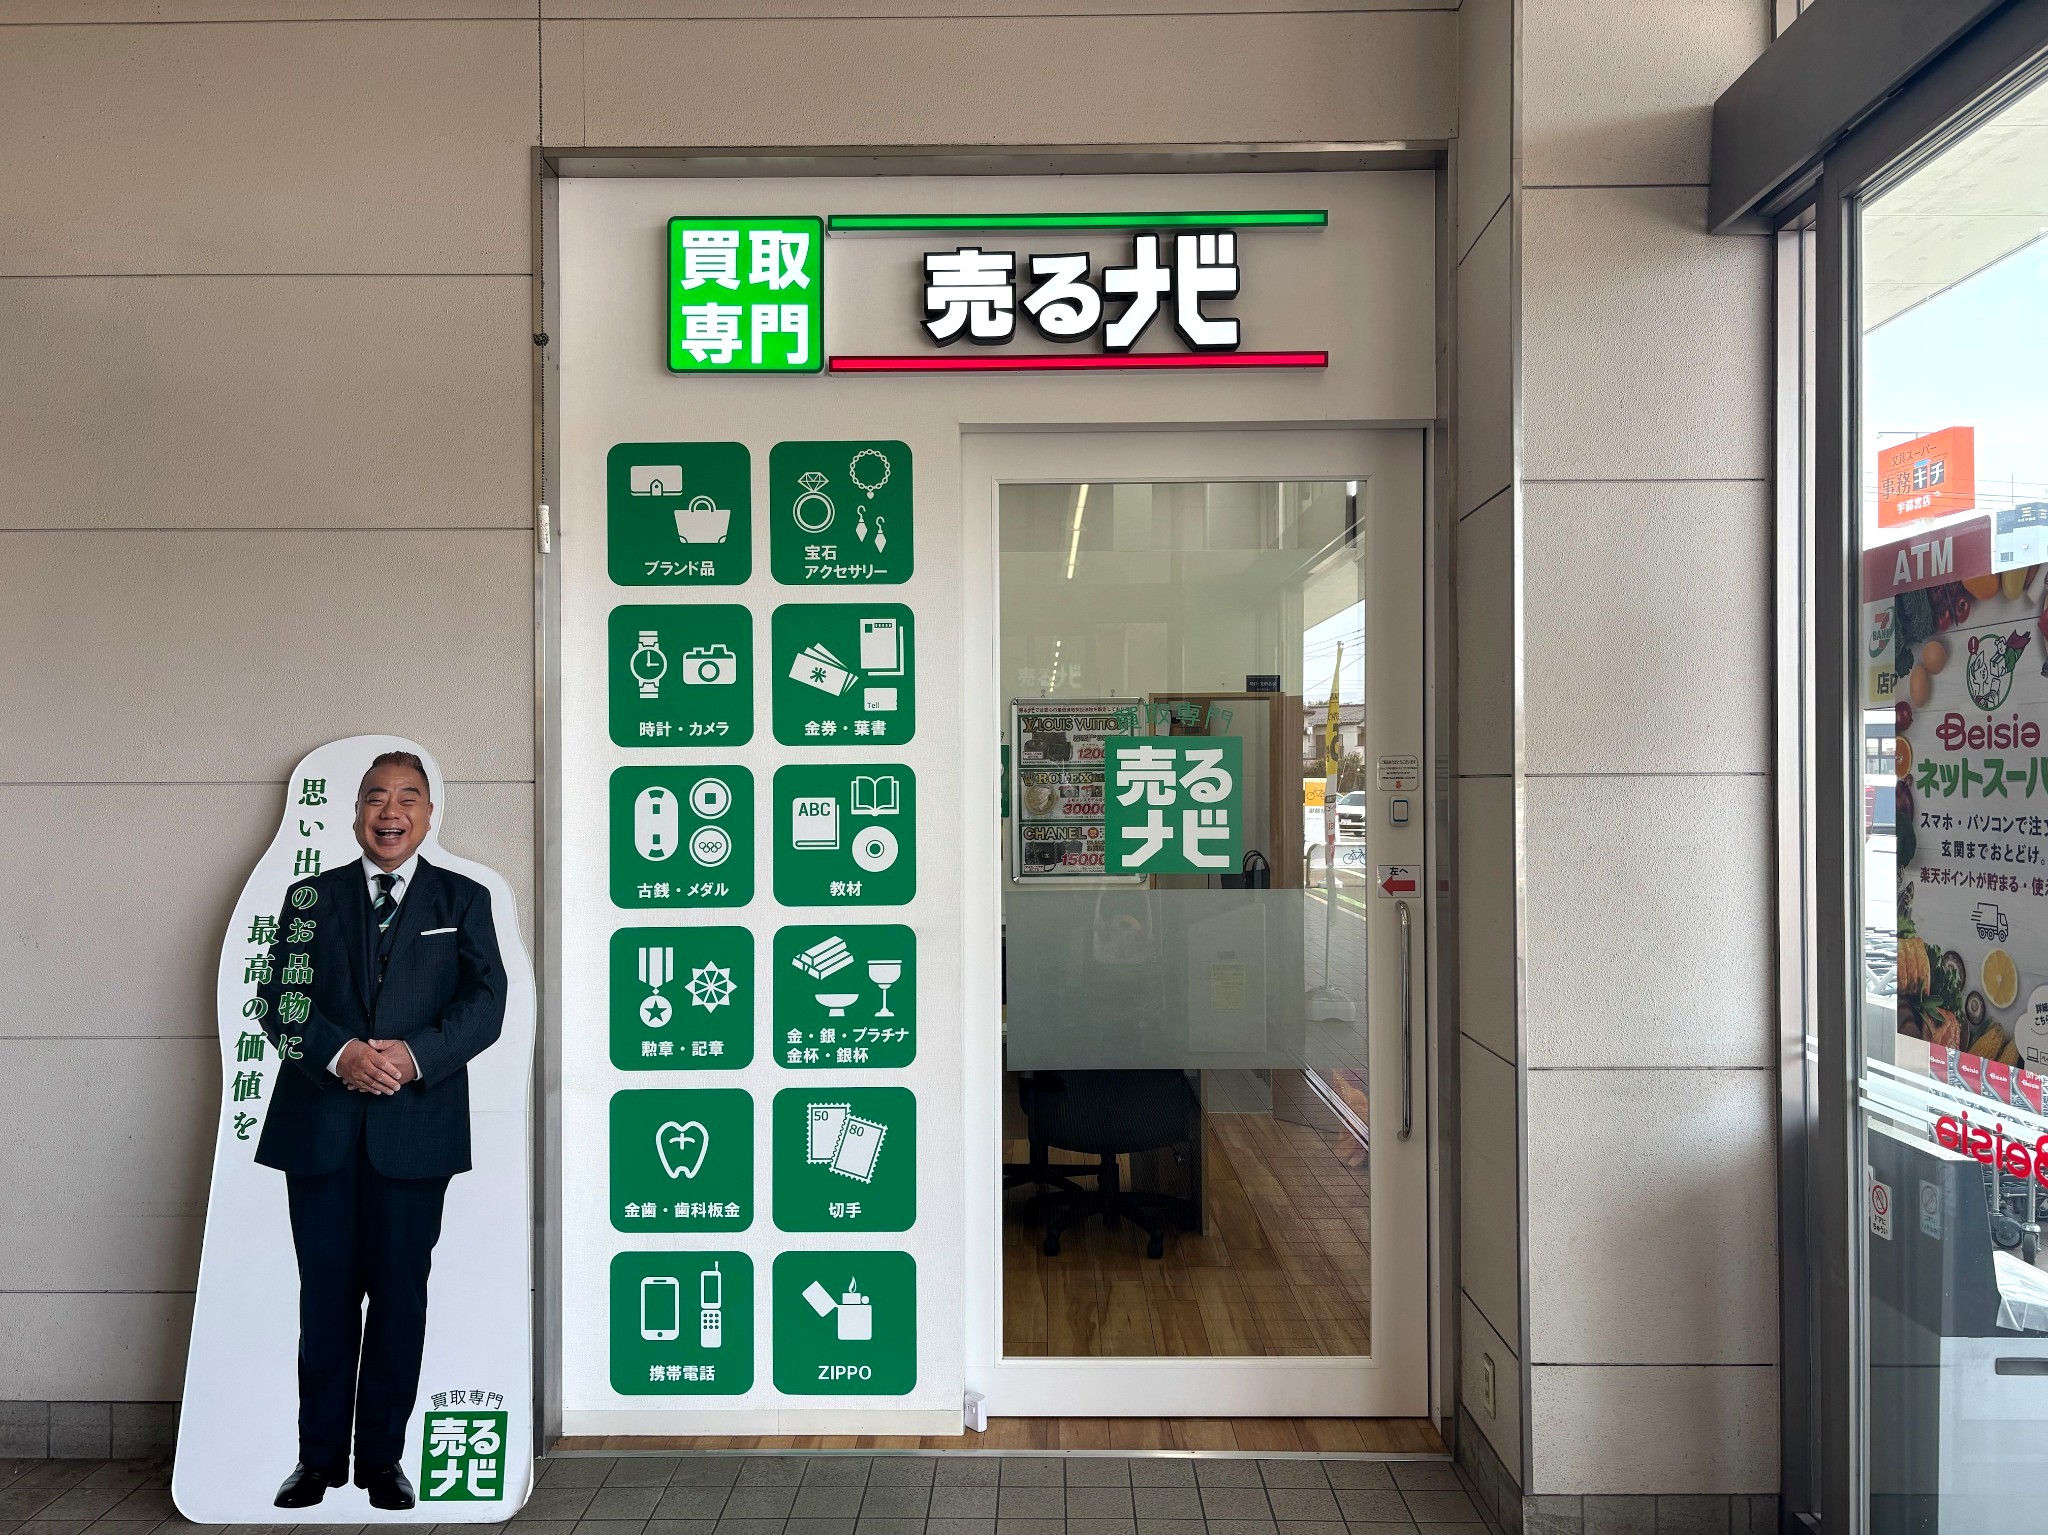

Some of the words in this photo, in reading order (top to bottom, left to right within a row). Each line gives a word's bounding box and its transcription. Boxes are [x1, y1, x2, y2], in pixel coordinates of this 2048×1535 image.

[681, 230, 811, 291] 買取
[923, 232, 1240, 351] 売るナビ
[681, 302, 810, 365] 専門
[1881, 460, 1944, 500] 事務キチ
[804, 544, 837, 561] 宝石
[1892, 536, 1953, 586] ATM
[644, 560, 715, 577] ブランド品
[804, 564, 888, 580] アクセサリー
[1038, 717, 1073, 732] LOUIS
[1113, 701, 1234, 735] 買取専門
[639, 721, 730, 737] 時計・カメラ
[804, 719, 887, 736] 金券・葉書
[1936, 712, 2040, 751] Beisia
[1037, 771, 1093, 785] ROLEX
[1115, 745, 1233, 807] 売る
[798, 802, 831, 817] ABC
[1023, 826, 1087, 841] CHANEL
[1121, 809, 1230, 868] ナビ
[1941, 840, 2045, 866] 玄関までおとどけ。
[1389, 866, 1409, 876] 左へ
[829, 880, 863, 897] 教材
[1920, 865, 2048, 897] 楽天ポイントが貯まる・使
[637, 882, 730, 899] 古銭・メダル
[277, 777, 328, 1061] 思い出のお品物に
[231, 914, 280, 1141] 最高の価値を
[786, 1026, 910, 1044] 金・銀・プラチナ
[641, 1040, 724, 1057] 勲章・記章
[786, 1046, 869, 1064] 金杯・銀杯
[814, 1110, 829, 1121] 50
[849, 1124, 865, 1137] 80
[624, 1201, 740, 1218] 金歯・歯科板金
[828, 1201, 862, 1219] 切手
[649, 1365, 716, 1382] 携帯電話
[818, 1365, 872, 1380] ZIPPO
[430, 1389, 504, 1411] 買取専門
[429, 1417, 501, 1458] 売る
[429, 1458, 497, 1497] ナビ
